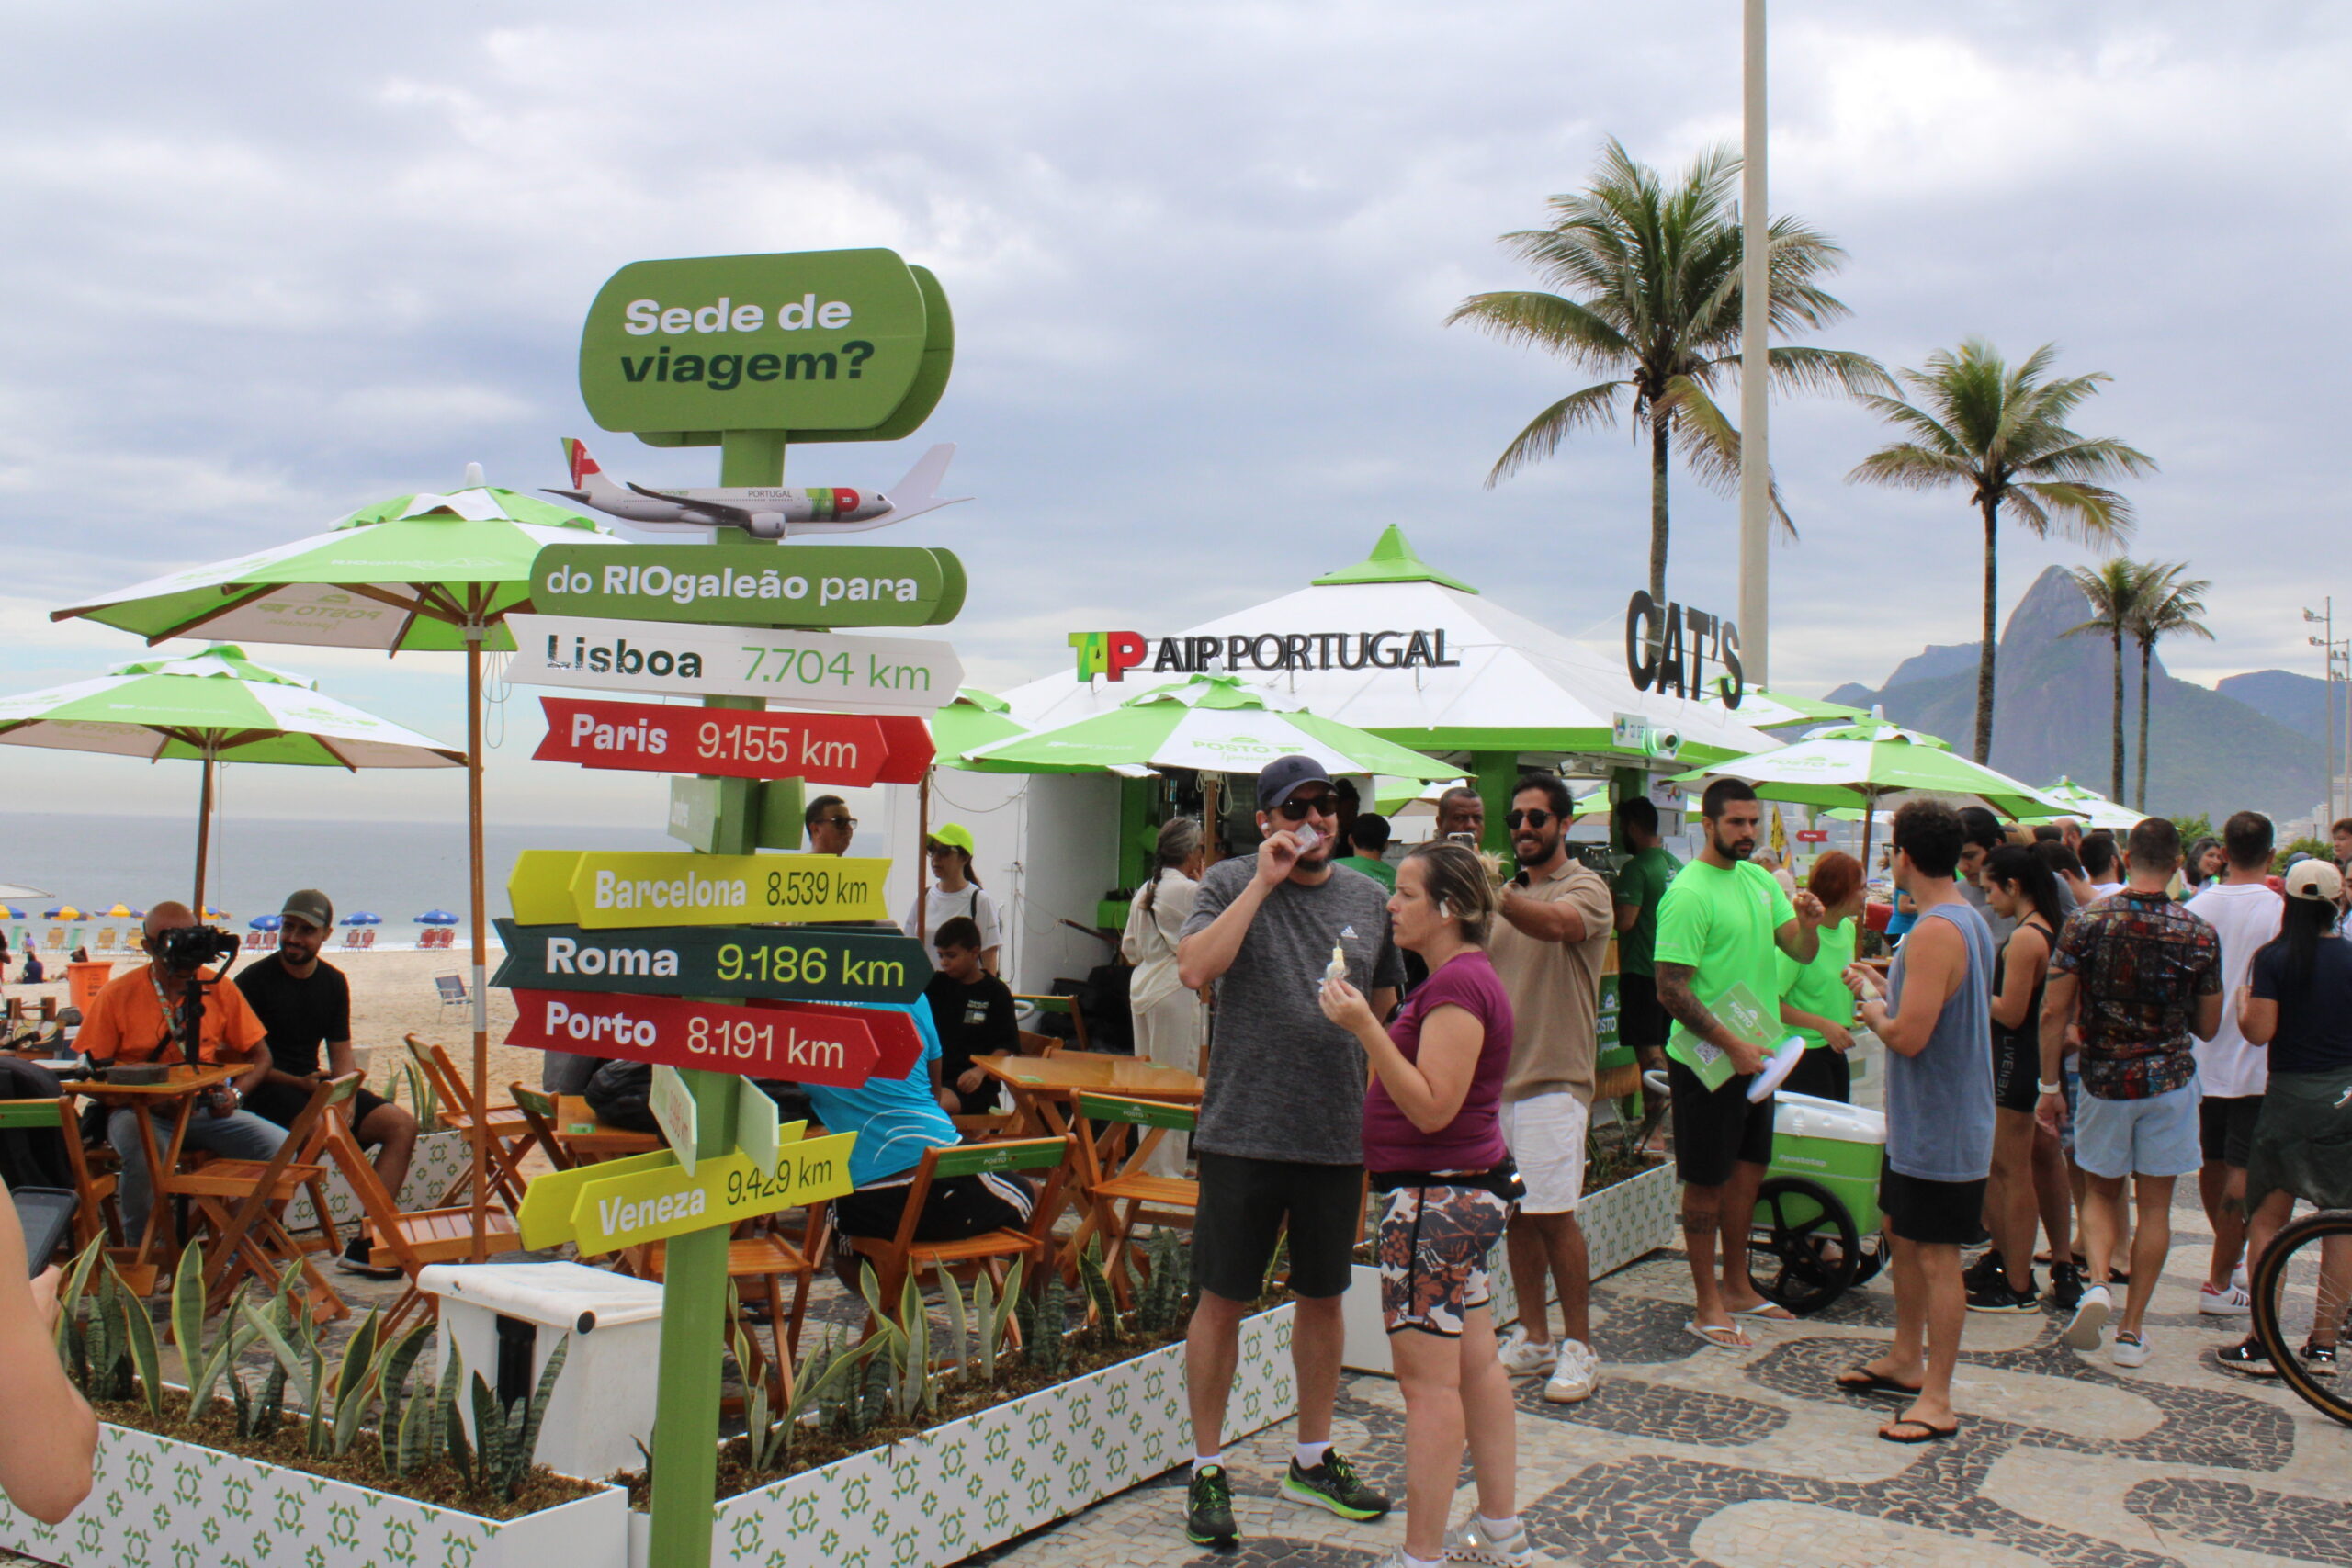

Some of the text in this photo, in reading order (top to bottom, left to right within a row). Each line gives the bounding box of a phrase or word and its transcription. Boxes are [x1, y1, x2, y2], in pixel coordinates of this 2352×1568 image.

[625, 293, 852, 336] Sede de
[620, 340, 875, 391] viagem?
[748, 490, 792, 498] PORTUGAL
[546, 564, 918, 606] do RIOgaleão para
[546, 634, 931, 692] Lisboa 7.704 km
[1068, 628, 1461, 683] TAP AIR PORTUGAL
[1625, 589, 1744, 711] CAT'S
[571, 713, 858, 769] Paris 9.155 km
[1191, 739, 1271, 754] POSTO
[594, 870, 868, 909] Barcelona 8.539 km
[546, 936, 904, 987] Roma 9.186 km
[545, 1001, 844, 1069] Porto 8.191 km
[1595, 1015, 1617, 1034] OSTO
[597, 1156, 832, 1236] Veneza 9.429 km
